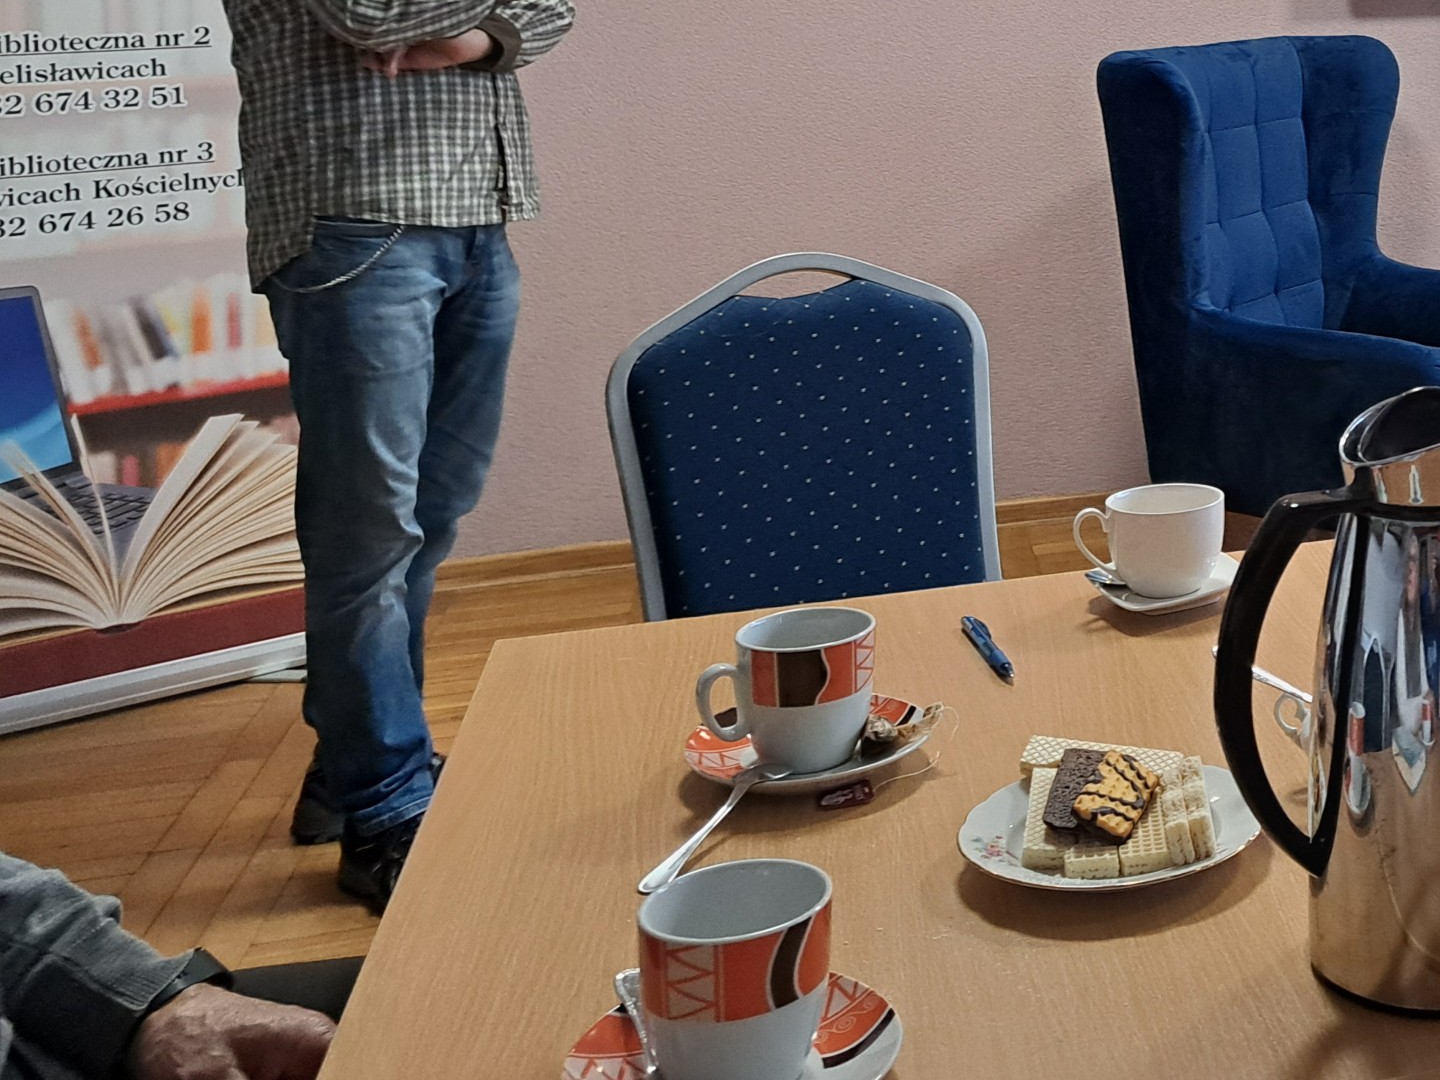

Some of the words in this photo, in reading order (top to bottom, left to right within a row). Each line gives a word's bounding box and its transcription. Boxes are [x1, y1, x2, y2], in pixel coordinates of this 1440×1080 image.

[155, 33, 185, 47] nr
[194, 26, 211, 45] 2
[0, 58, 167, 84] elisławicach
[0, 94, 22, 115] 2
[35, 91, 94, 113] 674
[104, 89, 140, 109] 32
[152, 86, 185, 106] 51
[159, 149, 188, 164] nr
[197, 142, 214, 160] 3
[39, 210, 97, 234] 674
[107, 206, 144, 227] 26
[155, 201, 190, 223] 58
